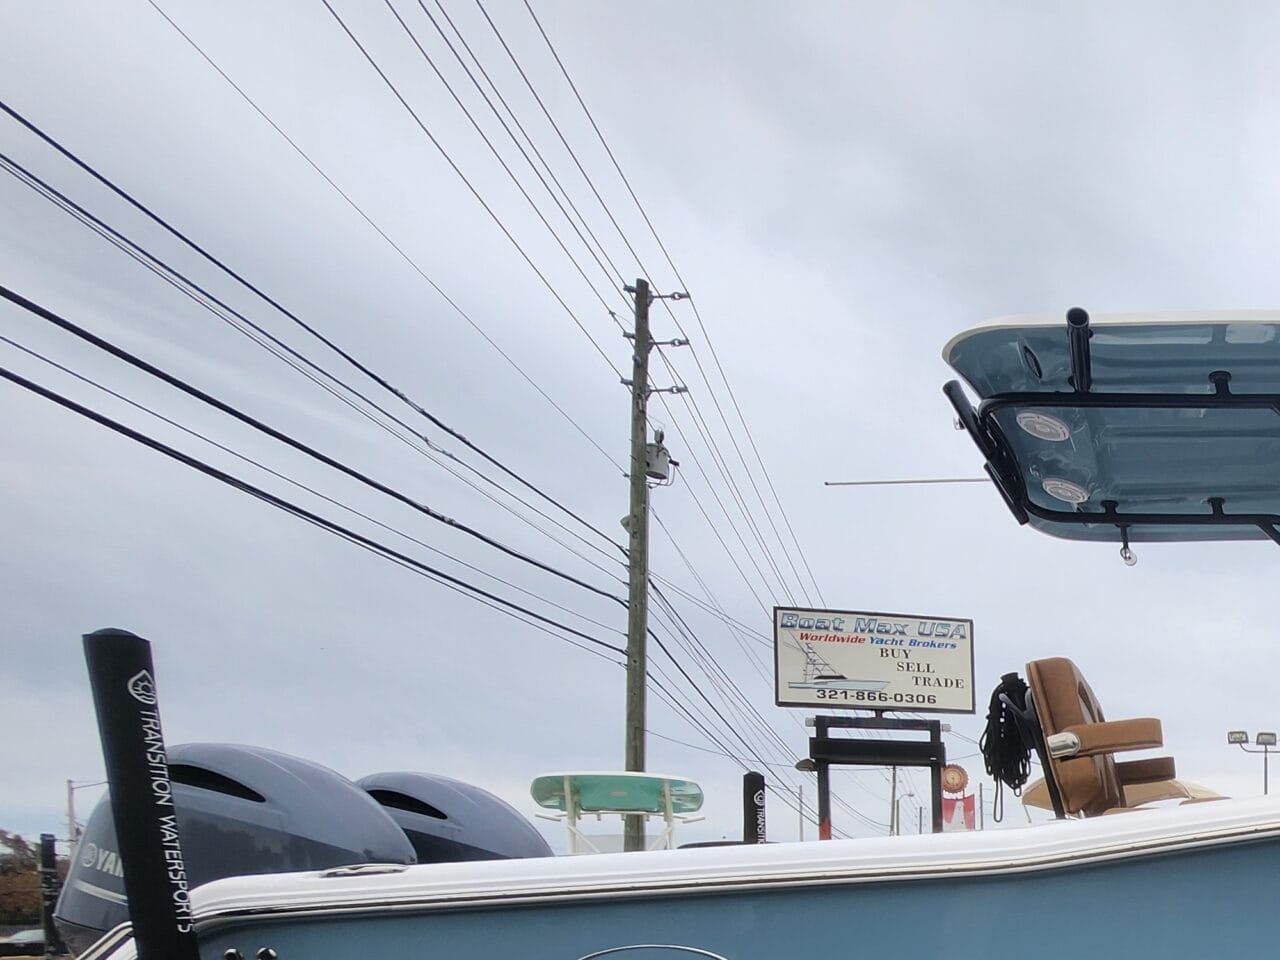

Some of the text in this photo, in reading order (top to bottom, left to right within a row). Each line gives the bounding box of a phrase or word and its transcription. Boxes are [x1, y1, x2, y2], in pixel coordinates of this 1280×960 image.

[780, 612, 967, 640] Boat Max USA
[799, 632, 957, 650] Worldwide Yacht Brokers
[879, 647, 912, 660] BUY
[896, 661, 935, 674] SELL
[911, 675, 965, 690] TRADE
[816, 689, 937, 705] 321-866-0306
[140, 708, 194, 934] TRANSITION WATERSPORTS
